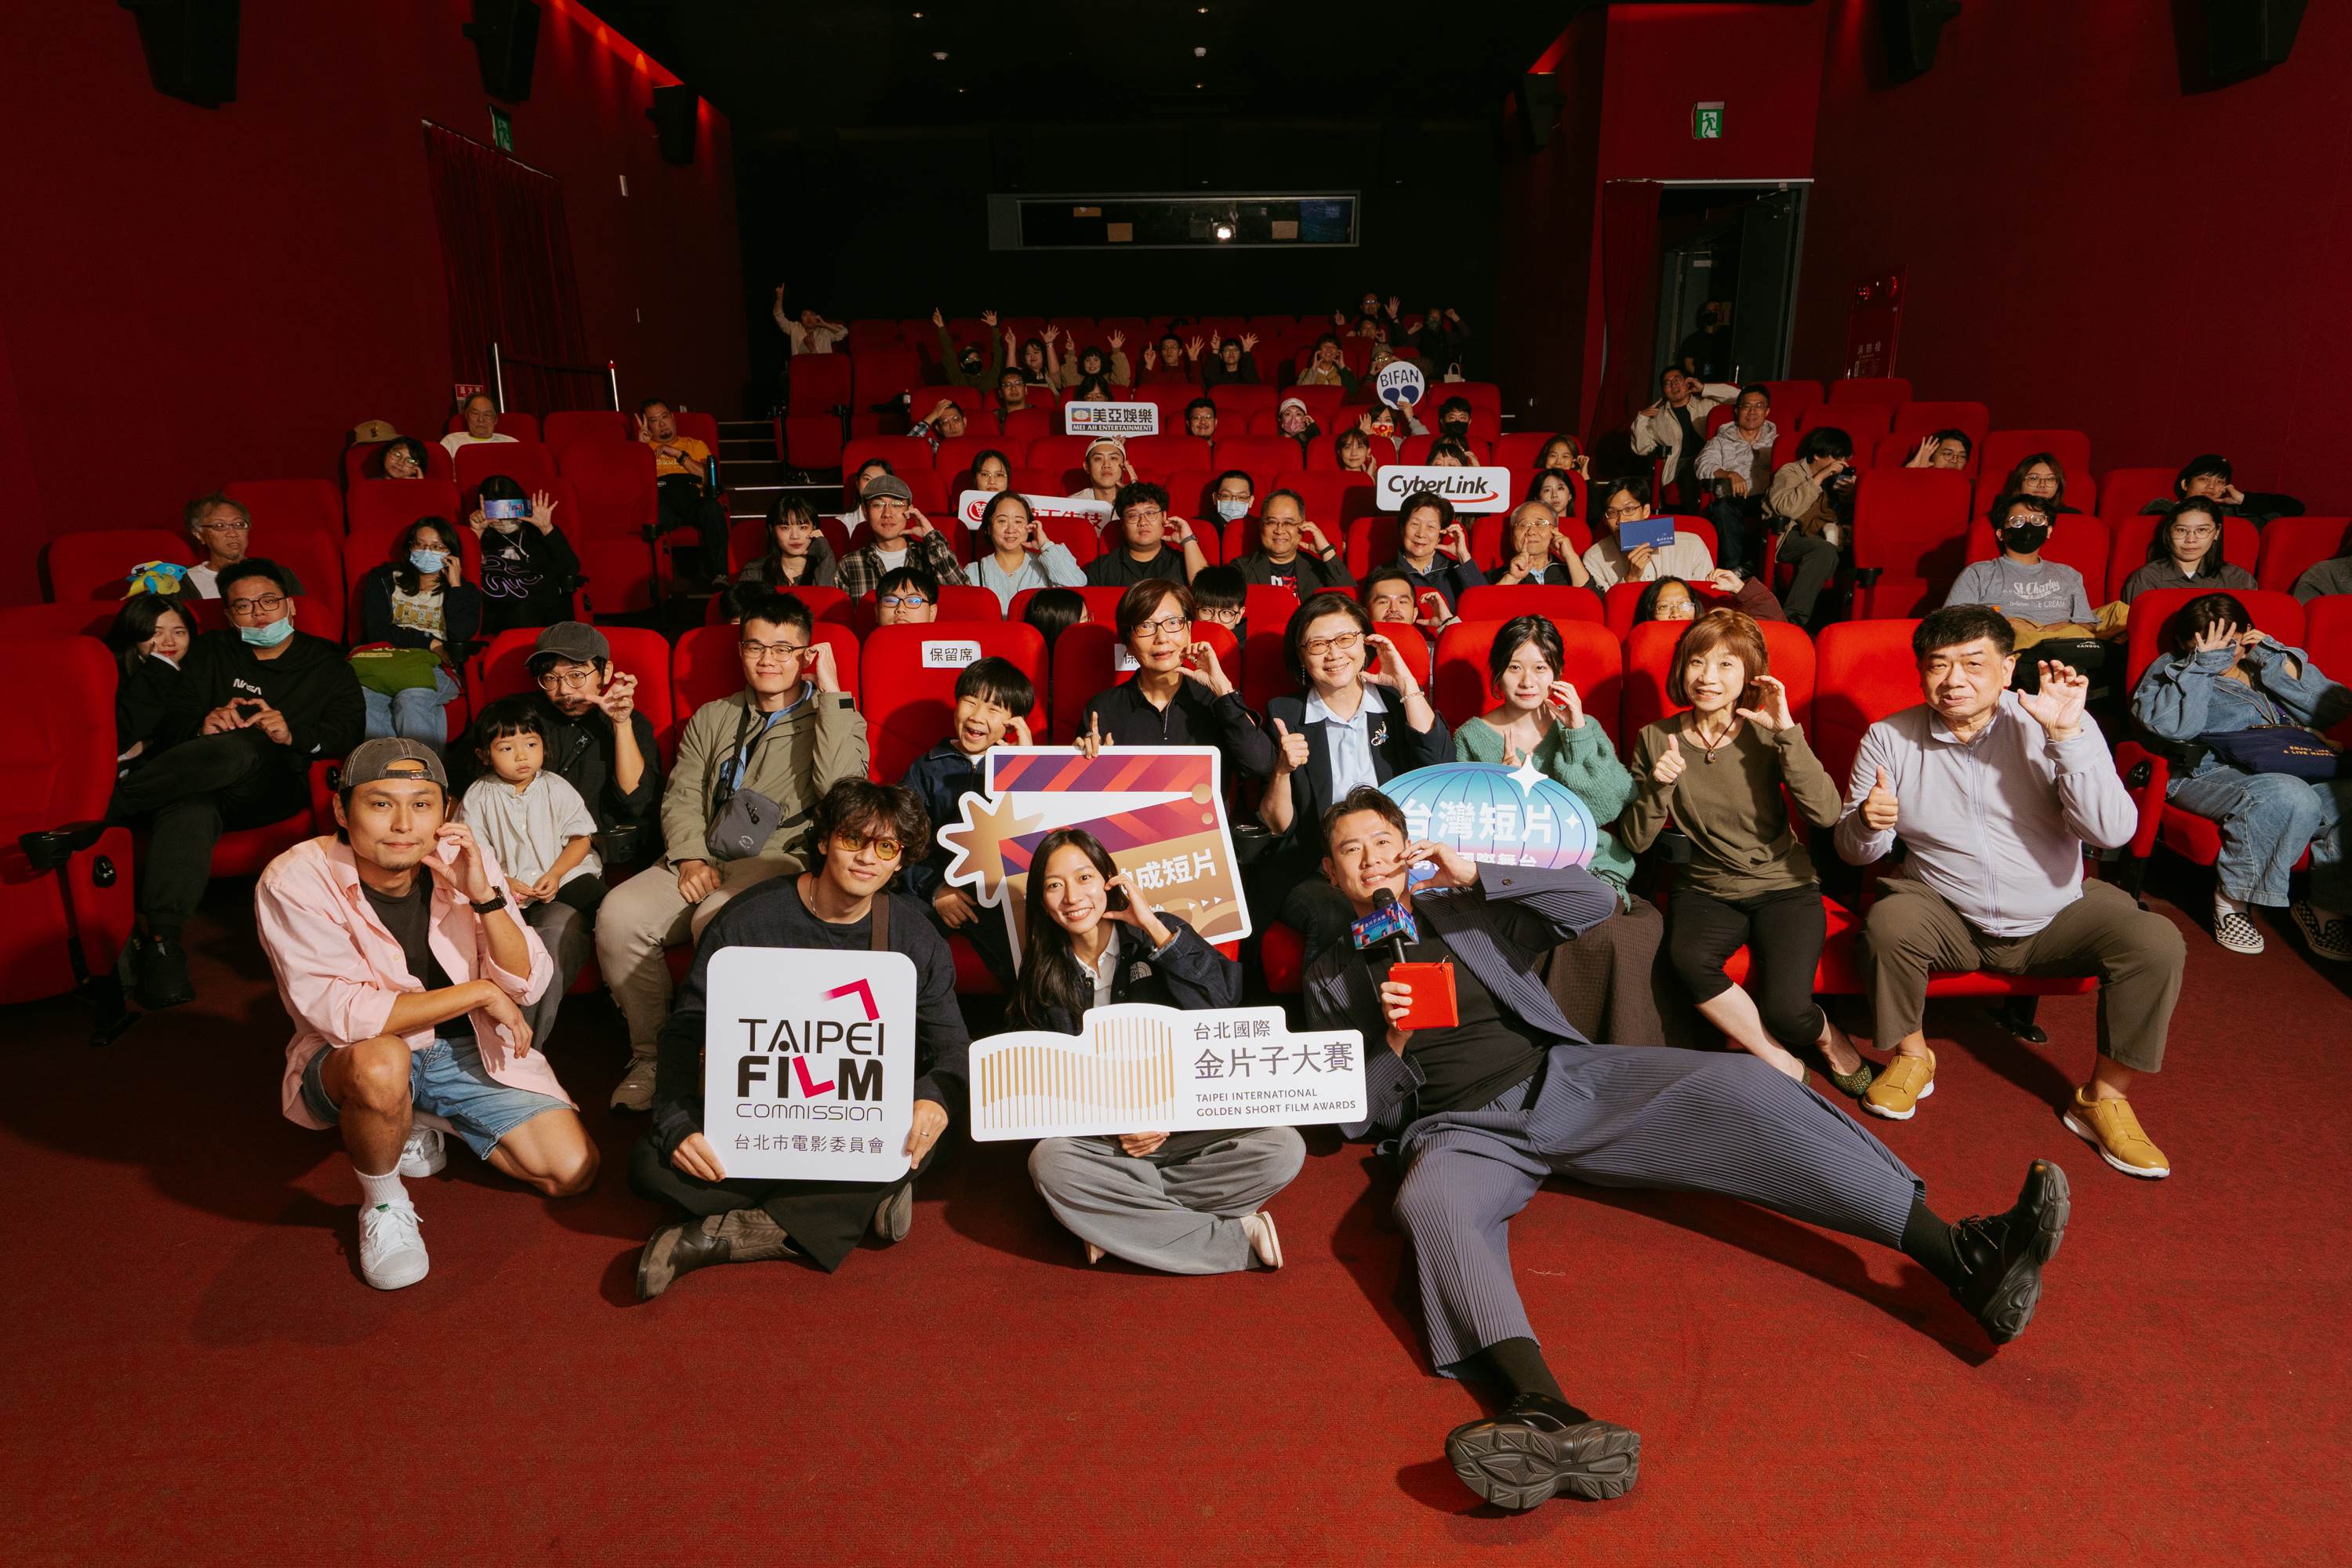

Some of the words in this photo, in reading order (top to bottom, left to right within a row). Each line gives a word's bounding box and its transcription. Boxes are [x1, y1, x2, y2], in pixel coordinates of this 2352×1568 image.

[1380, 369, 1419, 387] BIFAN
[1093, 408, 1152, 423] 美亞娛樂
[1388, 475, 1490, 497] CyberLink
[930, 648, 973, 662] 保留席
[233, 678, 262, 695] NASA
[1404, 799, 1552, 844] 台灣短片
[738, 1018, 884, 1056] TAIPEI
[1193, 1019, 1271, 1041] 台北國際
[1193, 1041, 1355, 1080] 金片子大賽
[737, 1055, 884, 1102] FILM
[1196, 1093, 1229, 1102] TAIPEI
[1232, 1088, 1318, 1101] INTERNATIONAL
[736, 1103, 884, 1122] COMMISSION
[1196, 1106, 1242, 1117] GOLDEN
[1246, 1105, 1281, 1115] SHORT
[1285, 1103, 1309, 1112] FILM
[1313, 1100, 1356, 1111] AWARDS
[735, 1134, 884, 1154] 台北市電影委員會
